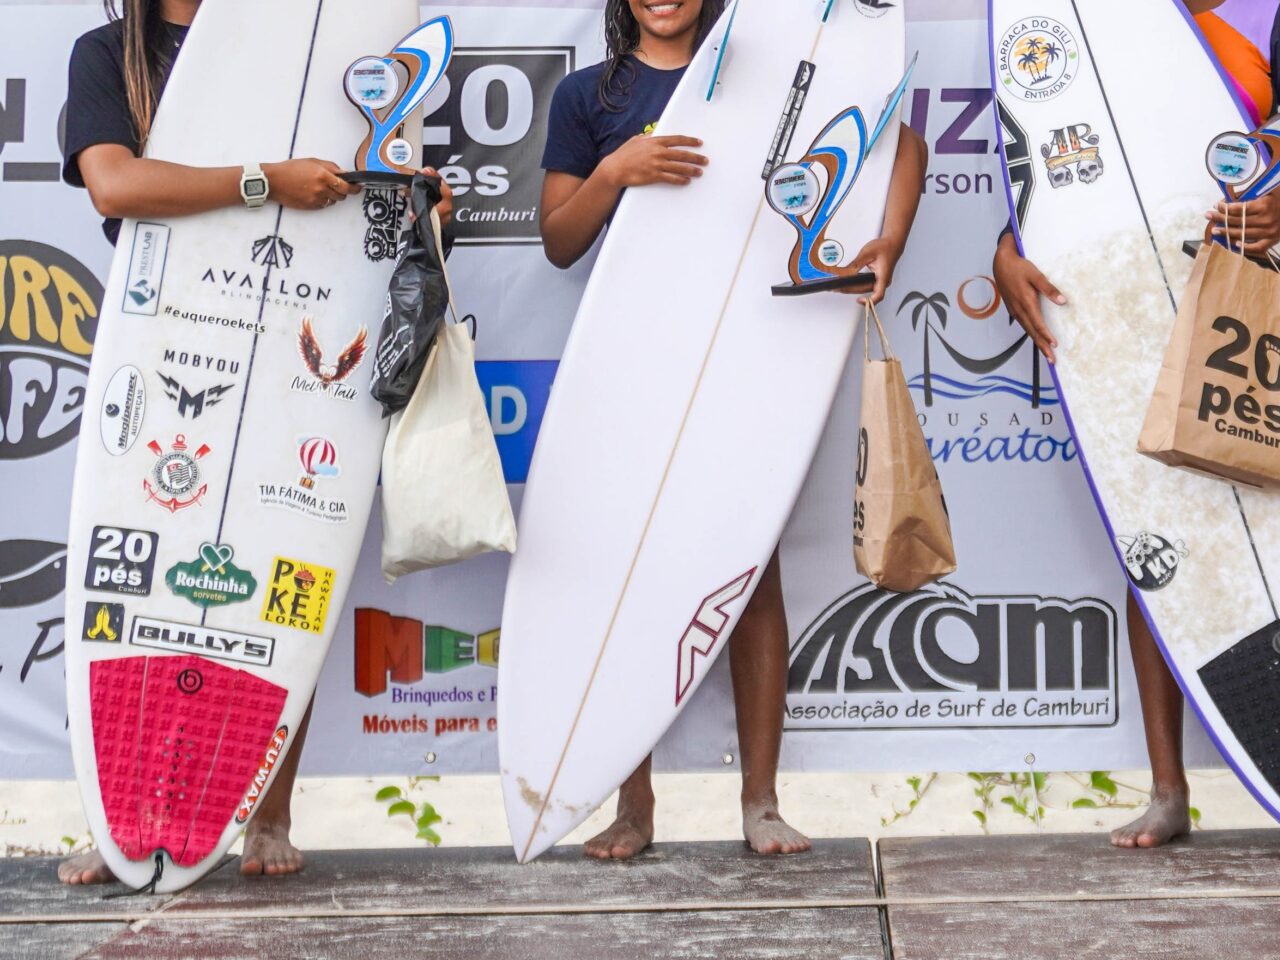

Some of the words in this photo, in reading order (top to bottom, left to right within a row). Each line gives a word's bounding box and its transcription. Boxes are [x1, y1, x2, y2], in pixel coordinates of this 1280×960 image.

[1000, 23, 1028, 71] BARRACA
[1032, 19, 1048, 29] DO
[1052, 26, 1071, 46] GILI
[1024, 81, 1067, 99] ENTRADA
[437, 155, 510, 197] és
[456, 207, 536, 223] Camburi
[201, 268, 332, 302] AVALLON
[221, 290, 308, 311] BLINDAGENS
[164, 348, 240, 374] MOBYOU
[259, 484, 276, 497] TIA
[278, 485, 317, 509] FÁTIMA
[319, 500, 326, 511] &
[329, 501, 346, 513] CIA
[93, 528, 152, 564] 20
[93, 561, 142, 586] pés
[175, 570, 248, 595] Rochinha
[118, 586, 147, 594] Camburi
[193, 591, 227, 602] sorvetes
[137, 624, 267, 656] BULLY'S
[392, 687, 473, 707] Brinquedos
[477, 691, 485, 702] e
[905, 699, 931, 718] de
[937, 697, 987, 718] Surf
[992, 697, 1017, 718] de
[1023, 696, 1109, 717] Camburi
[363, 714, 428, 735] Móveis
[435, 717, 480, 737] para
[240, 736, 284, 813] FU-WAX
